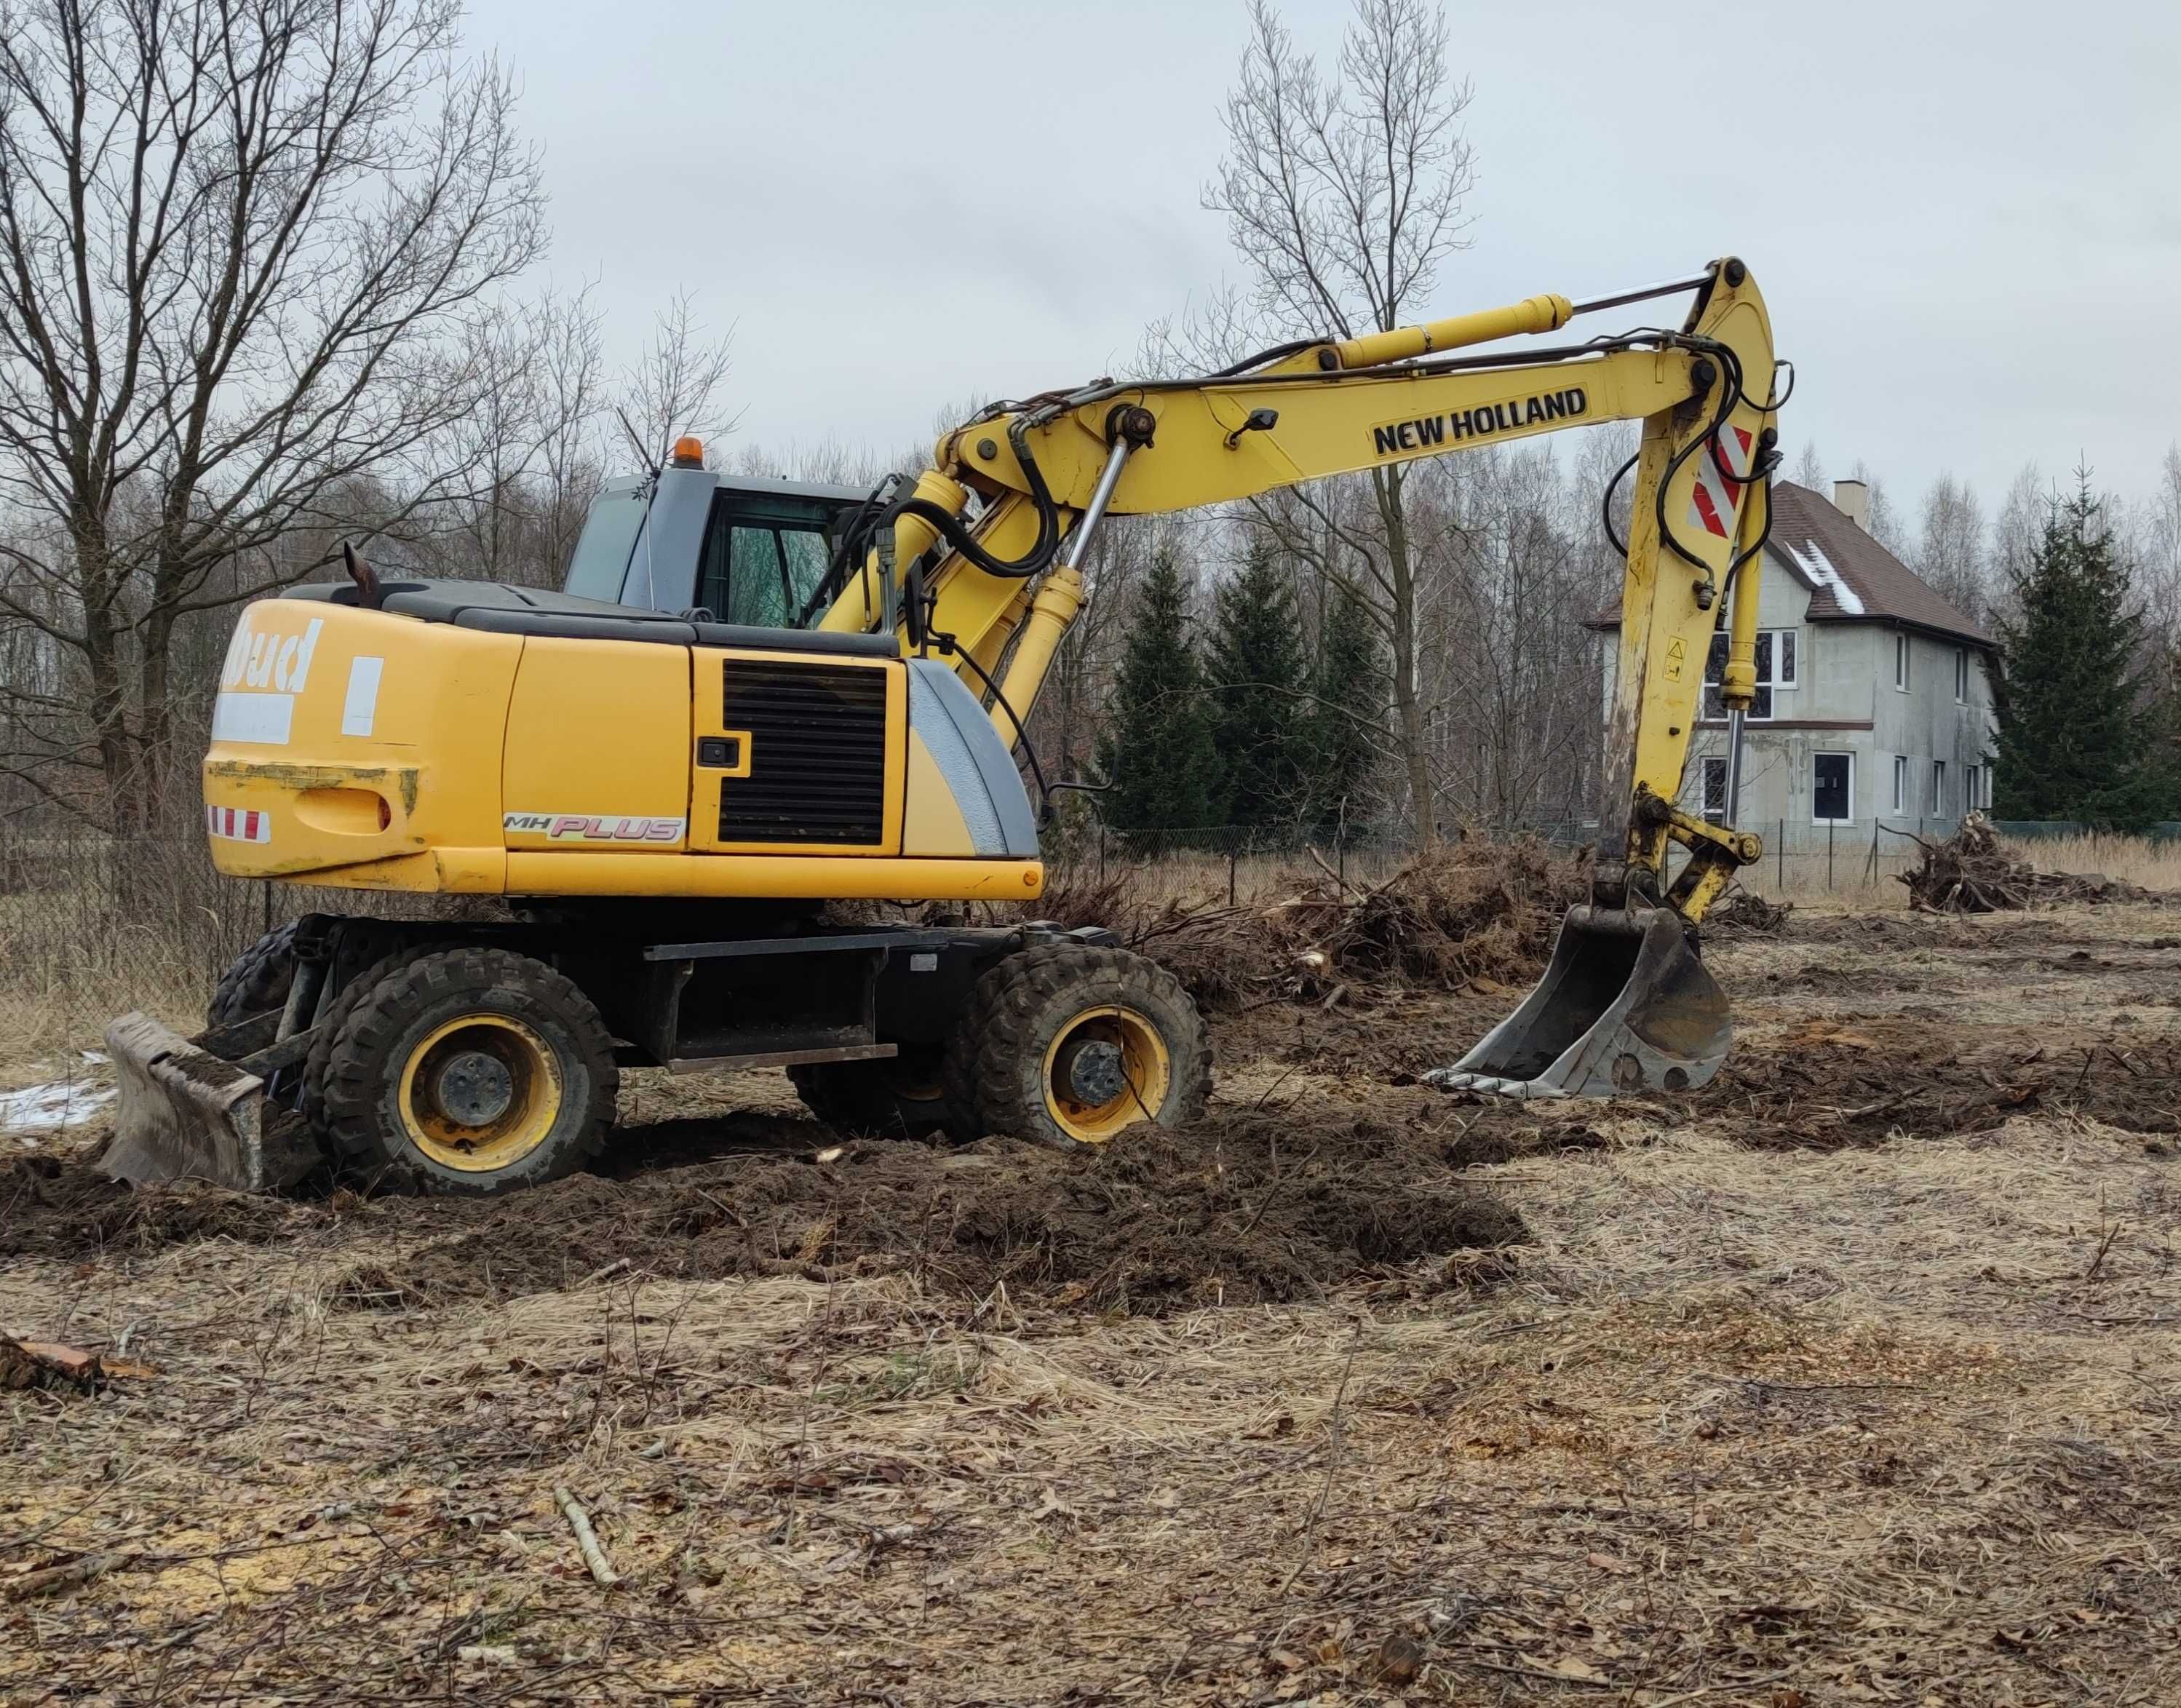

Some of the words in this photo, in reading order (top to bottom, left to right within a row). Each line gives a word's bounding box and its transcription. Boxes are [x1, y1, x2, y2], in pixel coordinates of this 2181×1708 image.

[1373, 416, 1443, 455] NEW
[1450, 388, 1586, 440] HOLLAND
[504, 817, 552, 829] MH
[550, 817, 681, 840] PLUS
